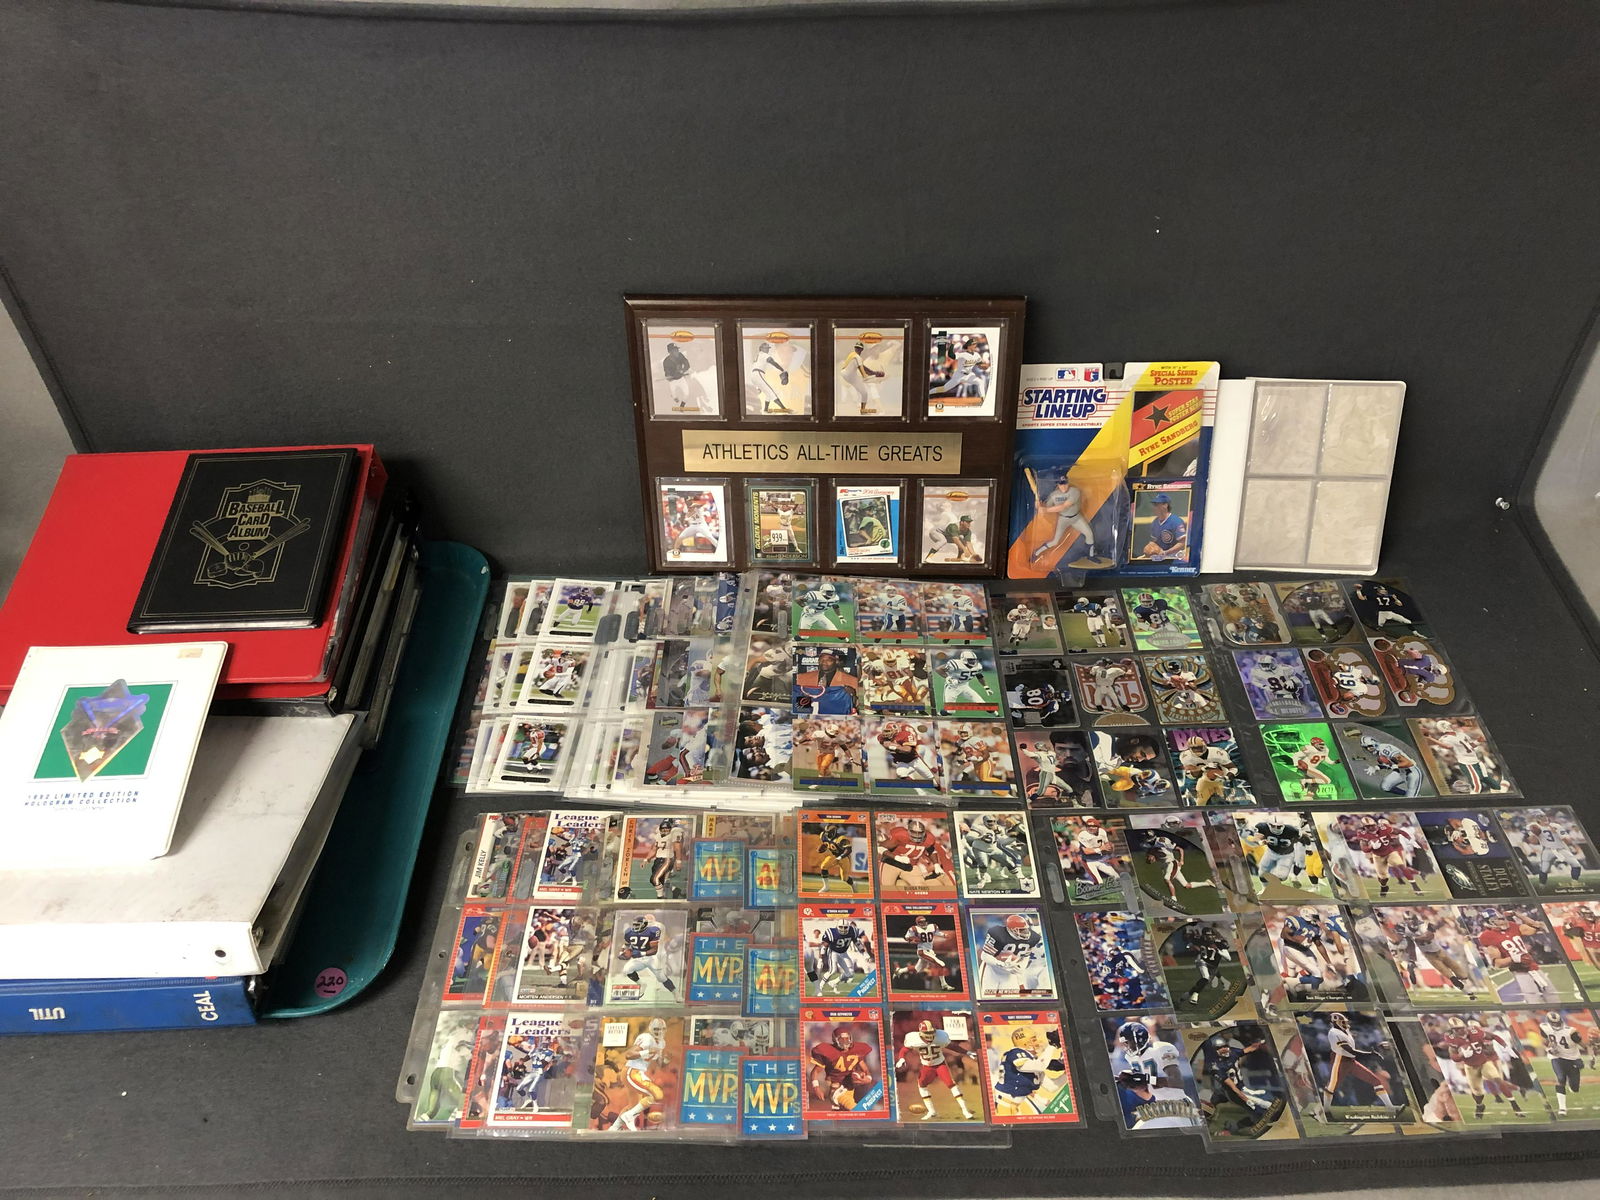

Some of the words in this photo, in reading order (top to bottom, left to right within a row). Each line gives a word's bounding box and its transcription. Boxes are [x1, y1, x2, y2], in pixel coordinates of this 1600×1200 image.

[1154, 377, 1192, 386] POSTER
[1024, 388, 1106, 405] STARTING
[1035, 403, 1095, 418] LINEUP
[1138, 443, 1160, 457] RYNE
[1160, 420, 1199, 445] SANDBERG
[702, 443, 789, 461] ATHLETICS
[796, 444, 869, 462] ALL-TIME
[878, 445, 943, 462] GREATS
[228, 500, 285, 516] BASEBALL
[752, 491, 760, 524] MOMENTS
[237, 513, 272, 526] CARD
[229, 526, 270, 538] ALBUM
[753, 524, 761, 550] GOLDEN
[771, 532, 783, 543] 939
[1169, 566, 1197, 574] Kenner
[1376, 596, 1390, 606] 17
[54, 792, 94, 800] LIMITED
[99, 790, 139, 798] EDITION
[24, 799, 74, 807] HOLOGRAM
[79, 797, 137, 805] COLLECTION
[554, 813, 600, 821] League
[1542, 829, 1555, 842] 3
[479, 850, 488, 867] KELLY
[904, 844, 926, 860] 77
[629, 936, 650, 949] 27
[836, 937, 851, 949] 97
[919, 931, 934, 943] 80
[698, 939, 744, 950] THE
[316, 975, 345, 989] 220
[856, 977, 876, 997] PROSPECT
[193, 989, 220, 1022] CEAL
[512, 1017, 563, 1027] League
[514, 1027, 571, 1035] Leaders
[690, 1053, 738, 1065] THE
[919, 1045, 941, 1062] 25
[748, 1063, 797, 1075] THE
[862, 1088, 883, 1111] PROSPECT
